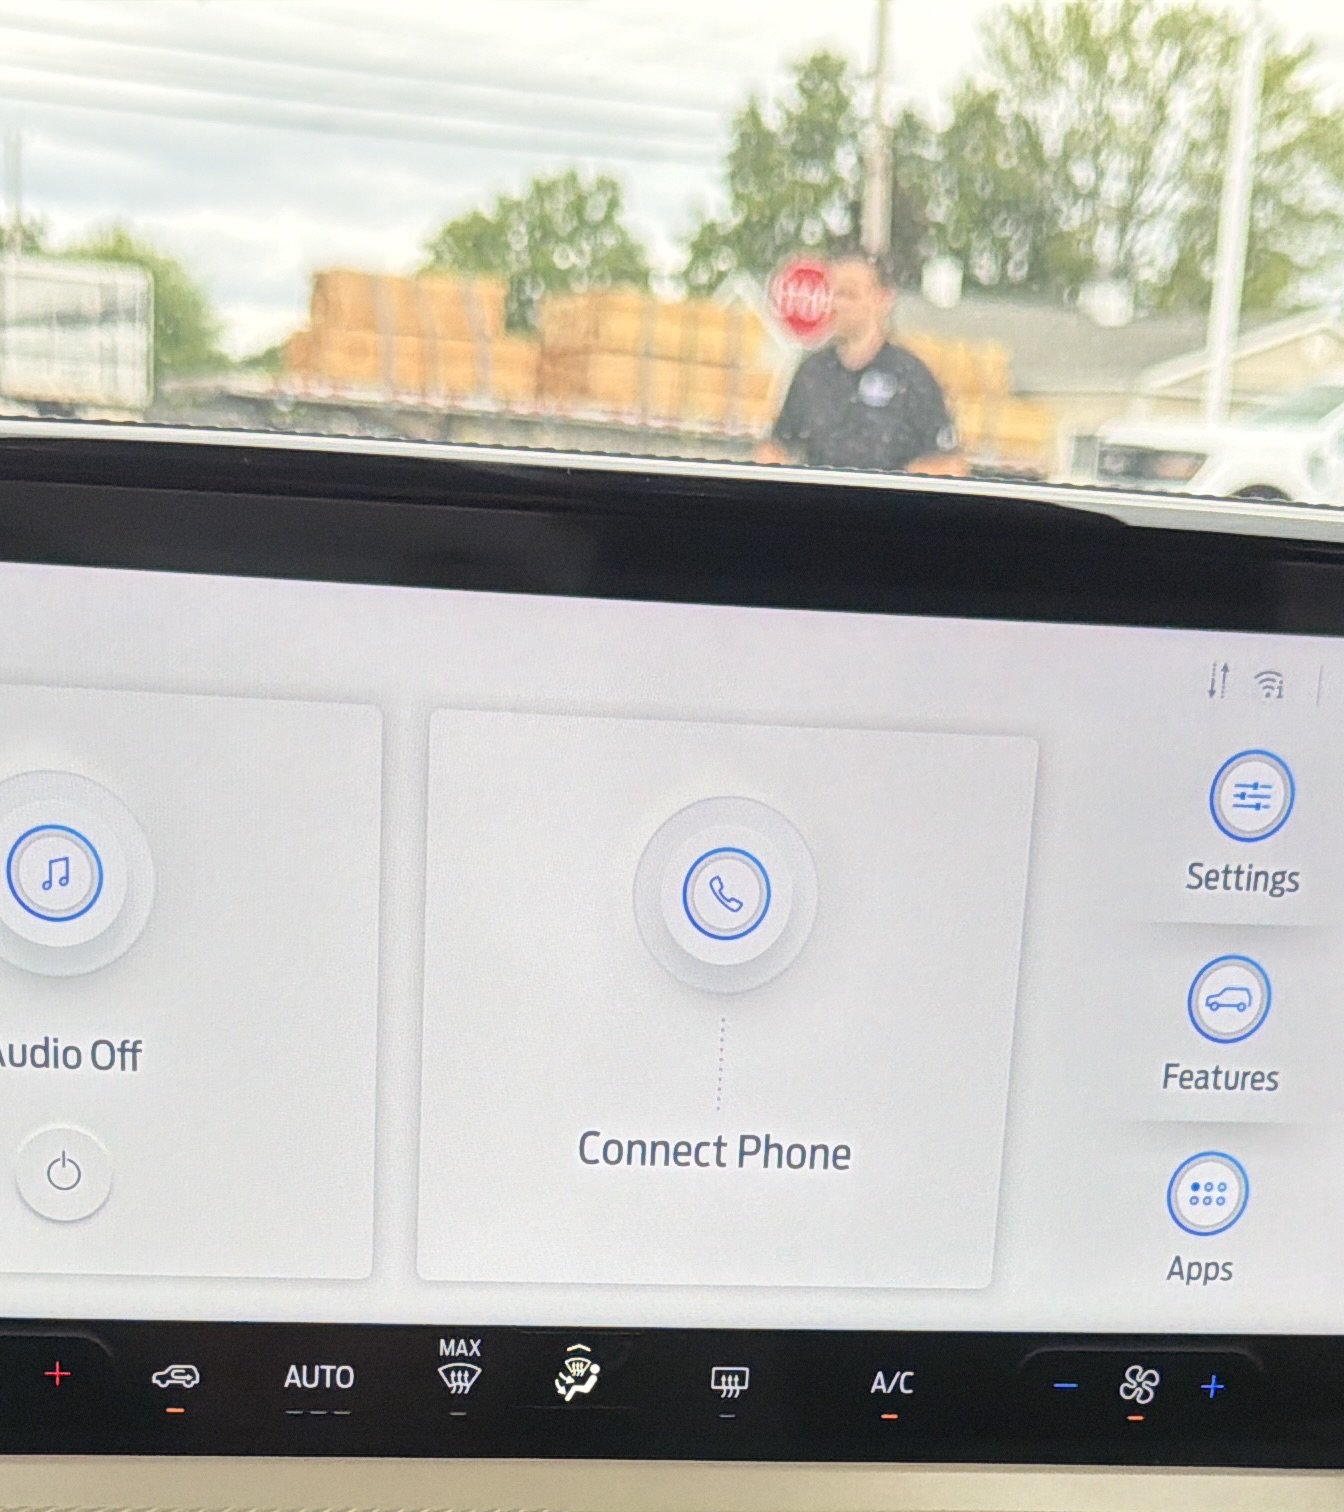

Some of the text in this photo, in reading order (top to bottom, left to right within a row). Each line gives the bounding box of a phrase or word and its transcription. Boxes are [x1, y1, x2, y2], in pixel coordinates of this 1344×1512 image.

[1185, 861, 1301, 898] Settings
[89, 1038, 143, 1072] Off
[1161, 1062, 1280, 1092] Features
[578, 1129, 852, 1171] Connect Phone
[1165, 1255, 1234, 1286] Apps
[438, 1338, 482, 1358] MAX
[283, 1364, 355, 1389] AUTO
[870, 1370, 915, 1394] A/C
